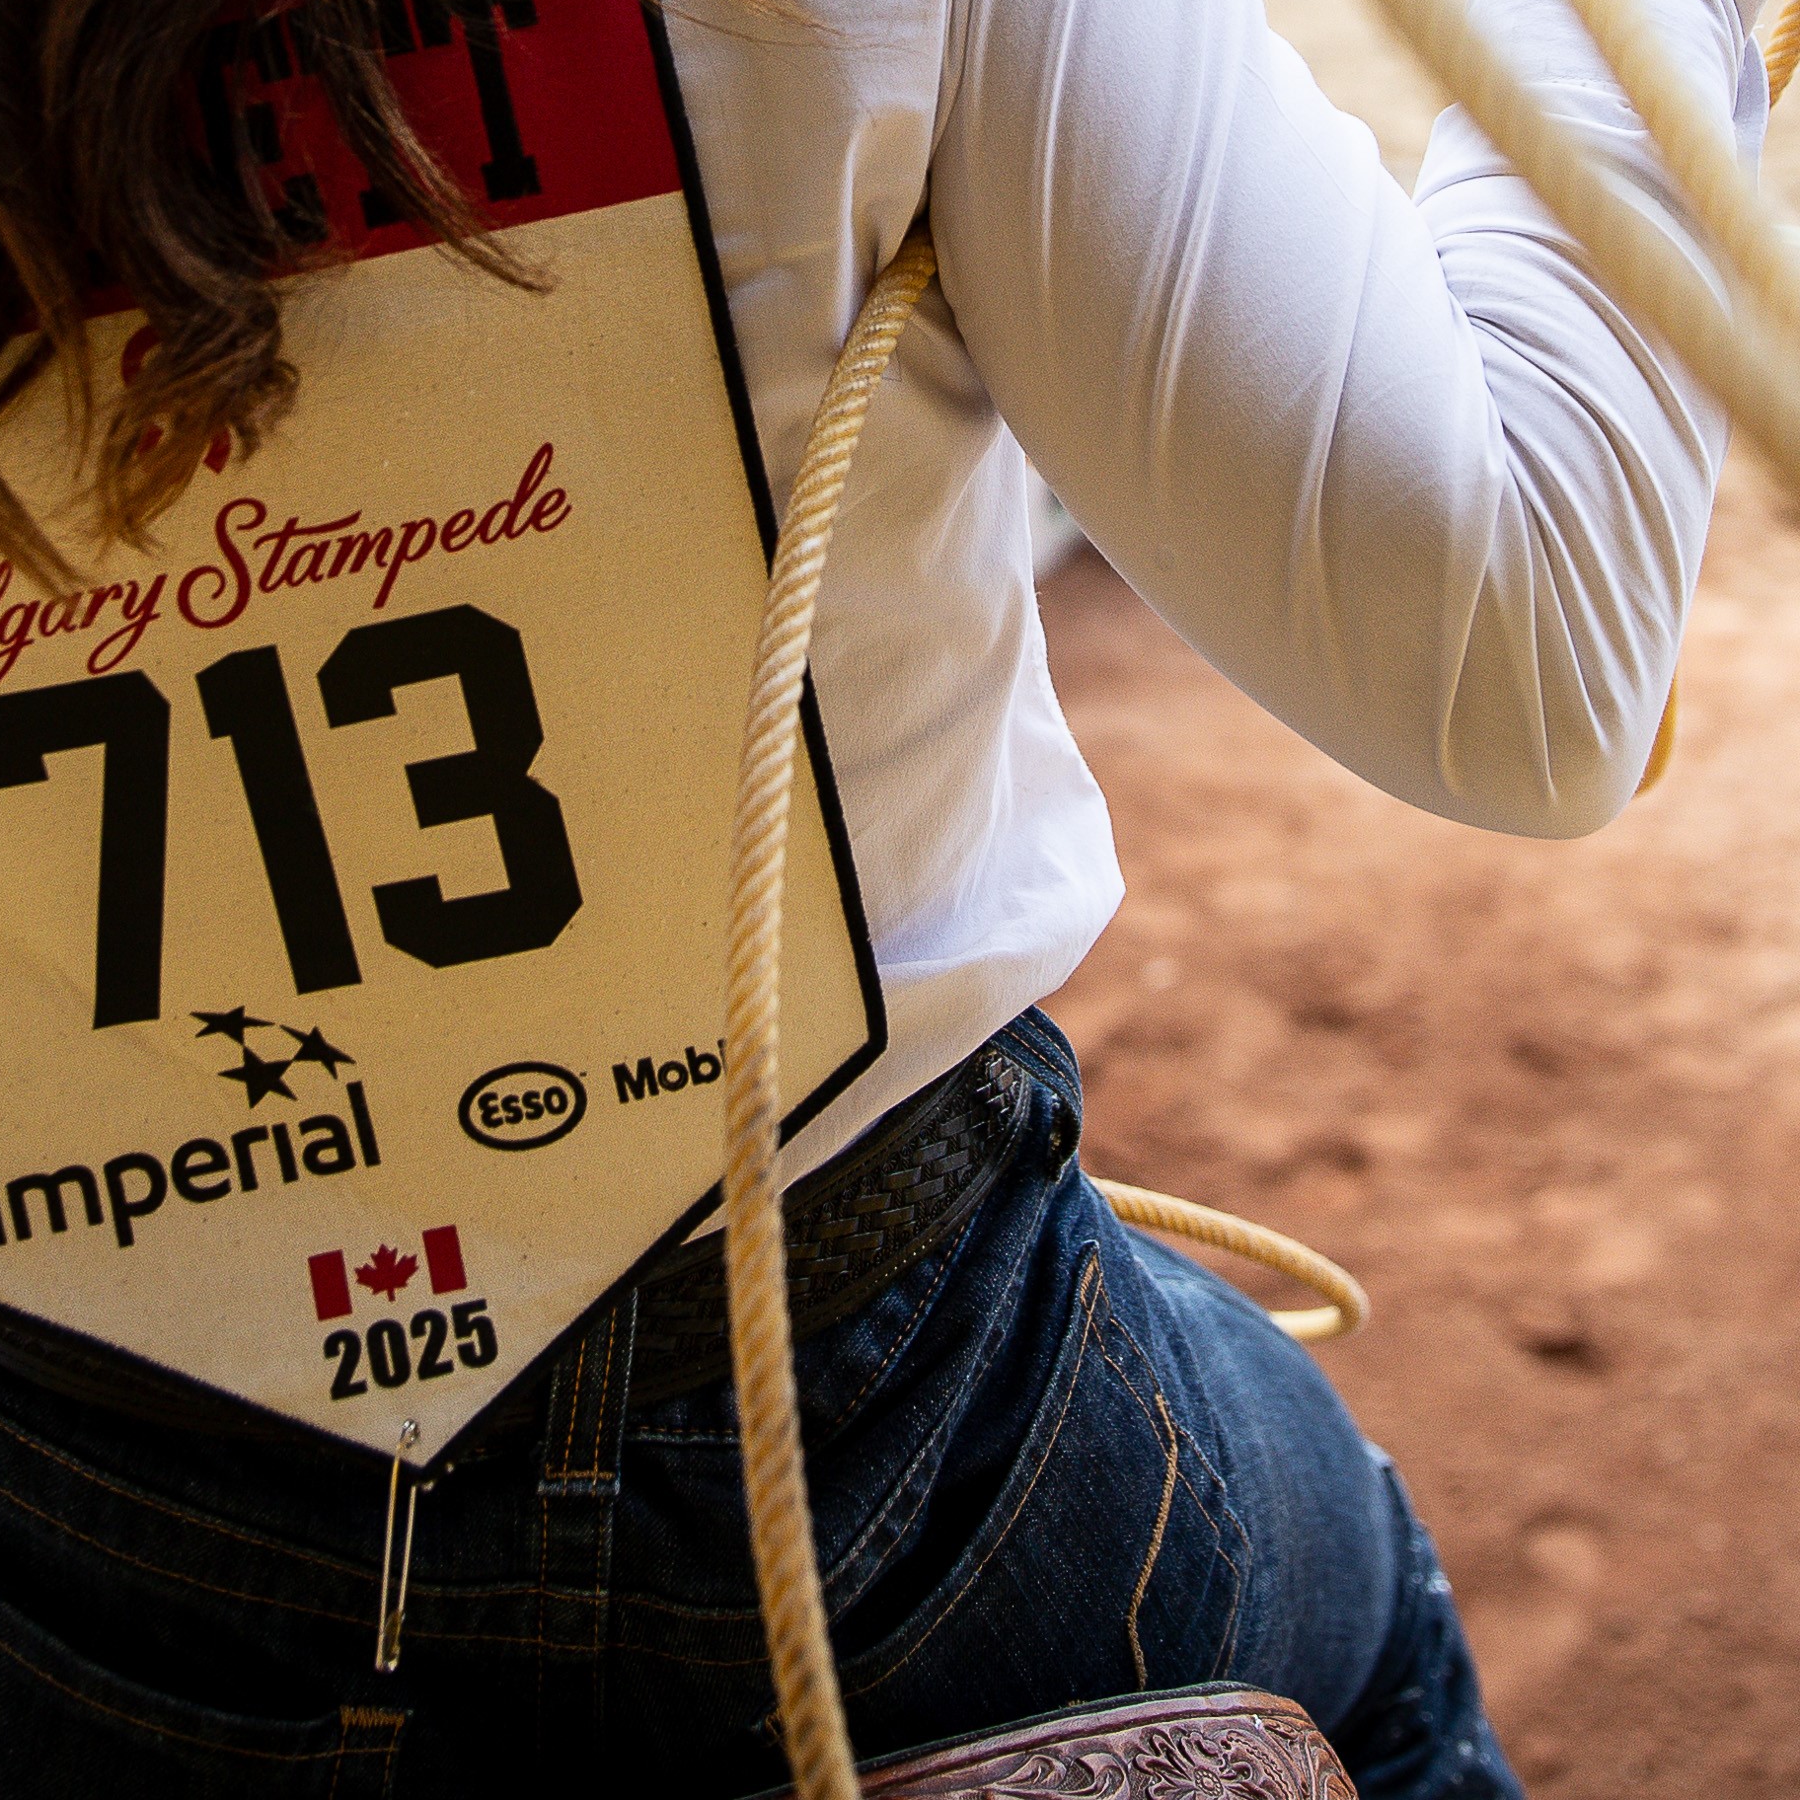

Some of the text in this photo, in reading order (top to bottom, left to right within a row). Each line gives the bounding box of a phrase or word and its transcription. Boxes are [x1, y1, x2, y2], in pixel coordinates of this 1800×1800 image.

[177, 442, 573, 630] Stampede
[477, 1085, 569, 1129] Esso
[323, 1299, 499, 1400] 2025
